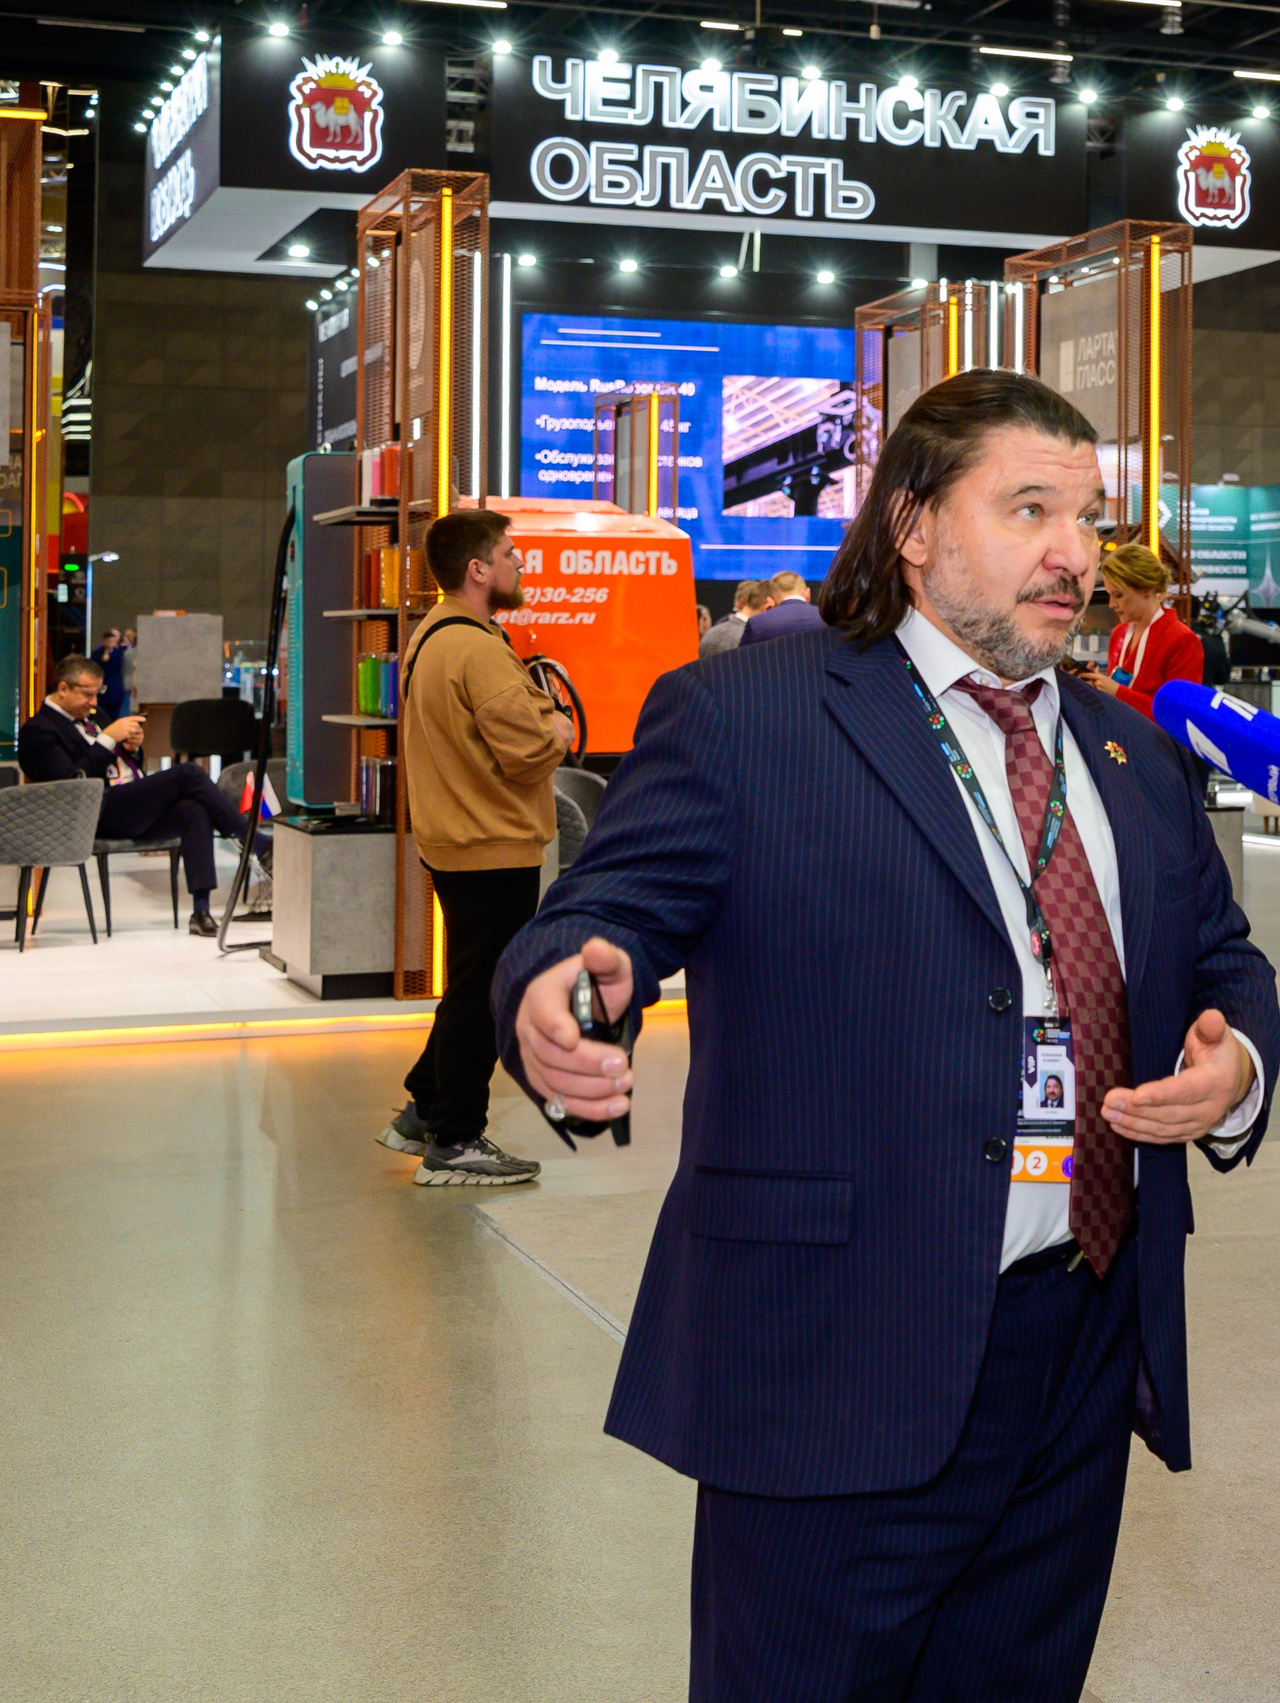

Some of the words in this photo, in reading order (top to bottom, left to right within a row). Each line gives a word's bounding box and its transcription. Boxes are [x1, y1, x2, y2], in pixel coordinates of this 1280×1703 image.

[531, 54, 1057, 157] ЧЕЛЯБИНСКАЯ
[530, 136, 876, 220] ОБЛАСТЬ
[1077, 331, 1116, 362] ЛАРТА
[534, 376, 588, 393] Модель
[1075, 359, 1116, 390] ГЛАСС
[559, 550, 678, 576] ОБЛАСТЬ
[1032, 1156, 1042, 1170] 2
